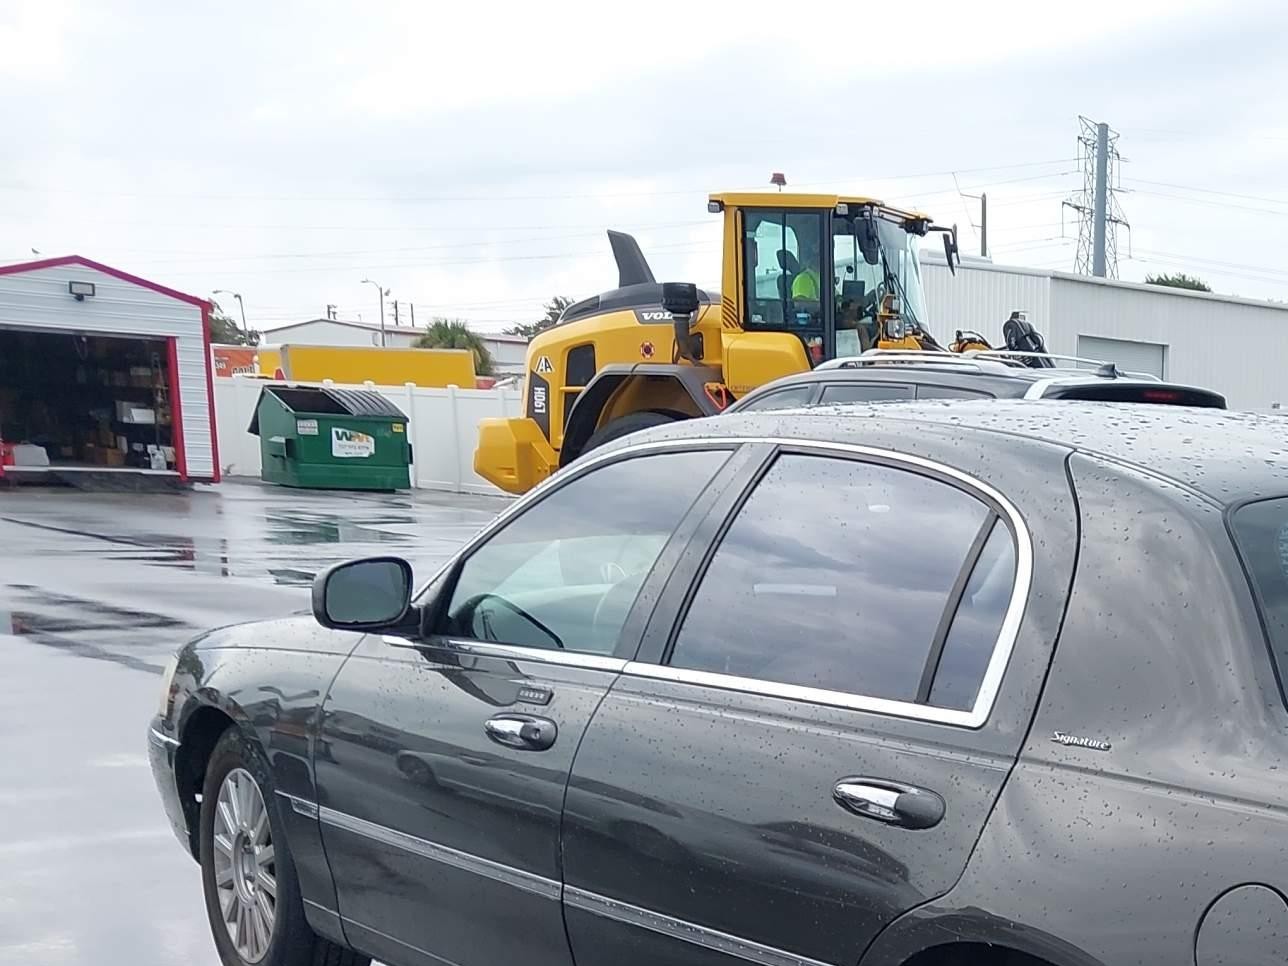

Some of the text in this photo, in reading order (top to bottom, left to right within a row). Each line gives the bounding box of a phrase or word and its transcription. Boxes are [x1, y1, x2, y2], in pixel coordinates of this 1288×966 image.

[642, 311, 693, 321] VOL
[534, 386, 546, 414] L90H
[1051, 731, 1109, 749] Signature
